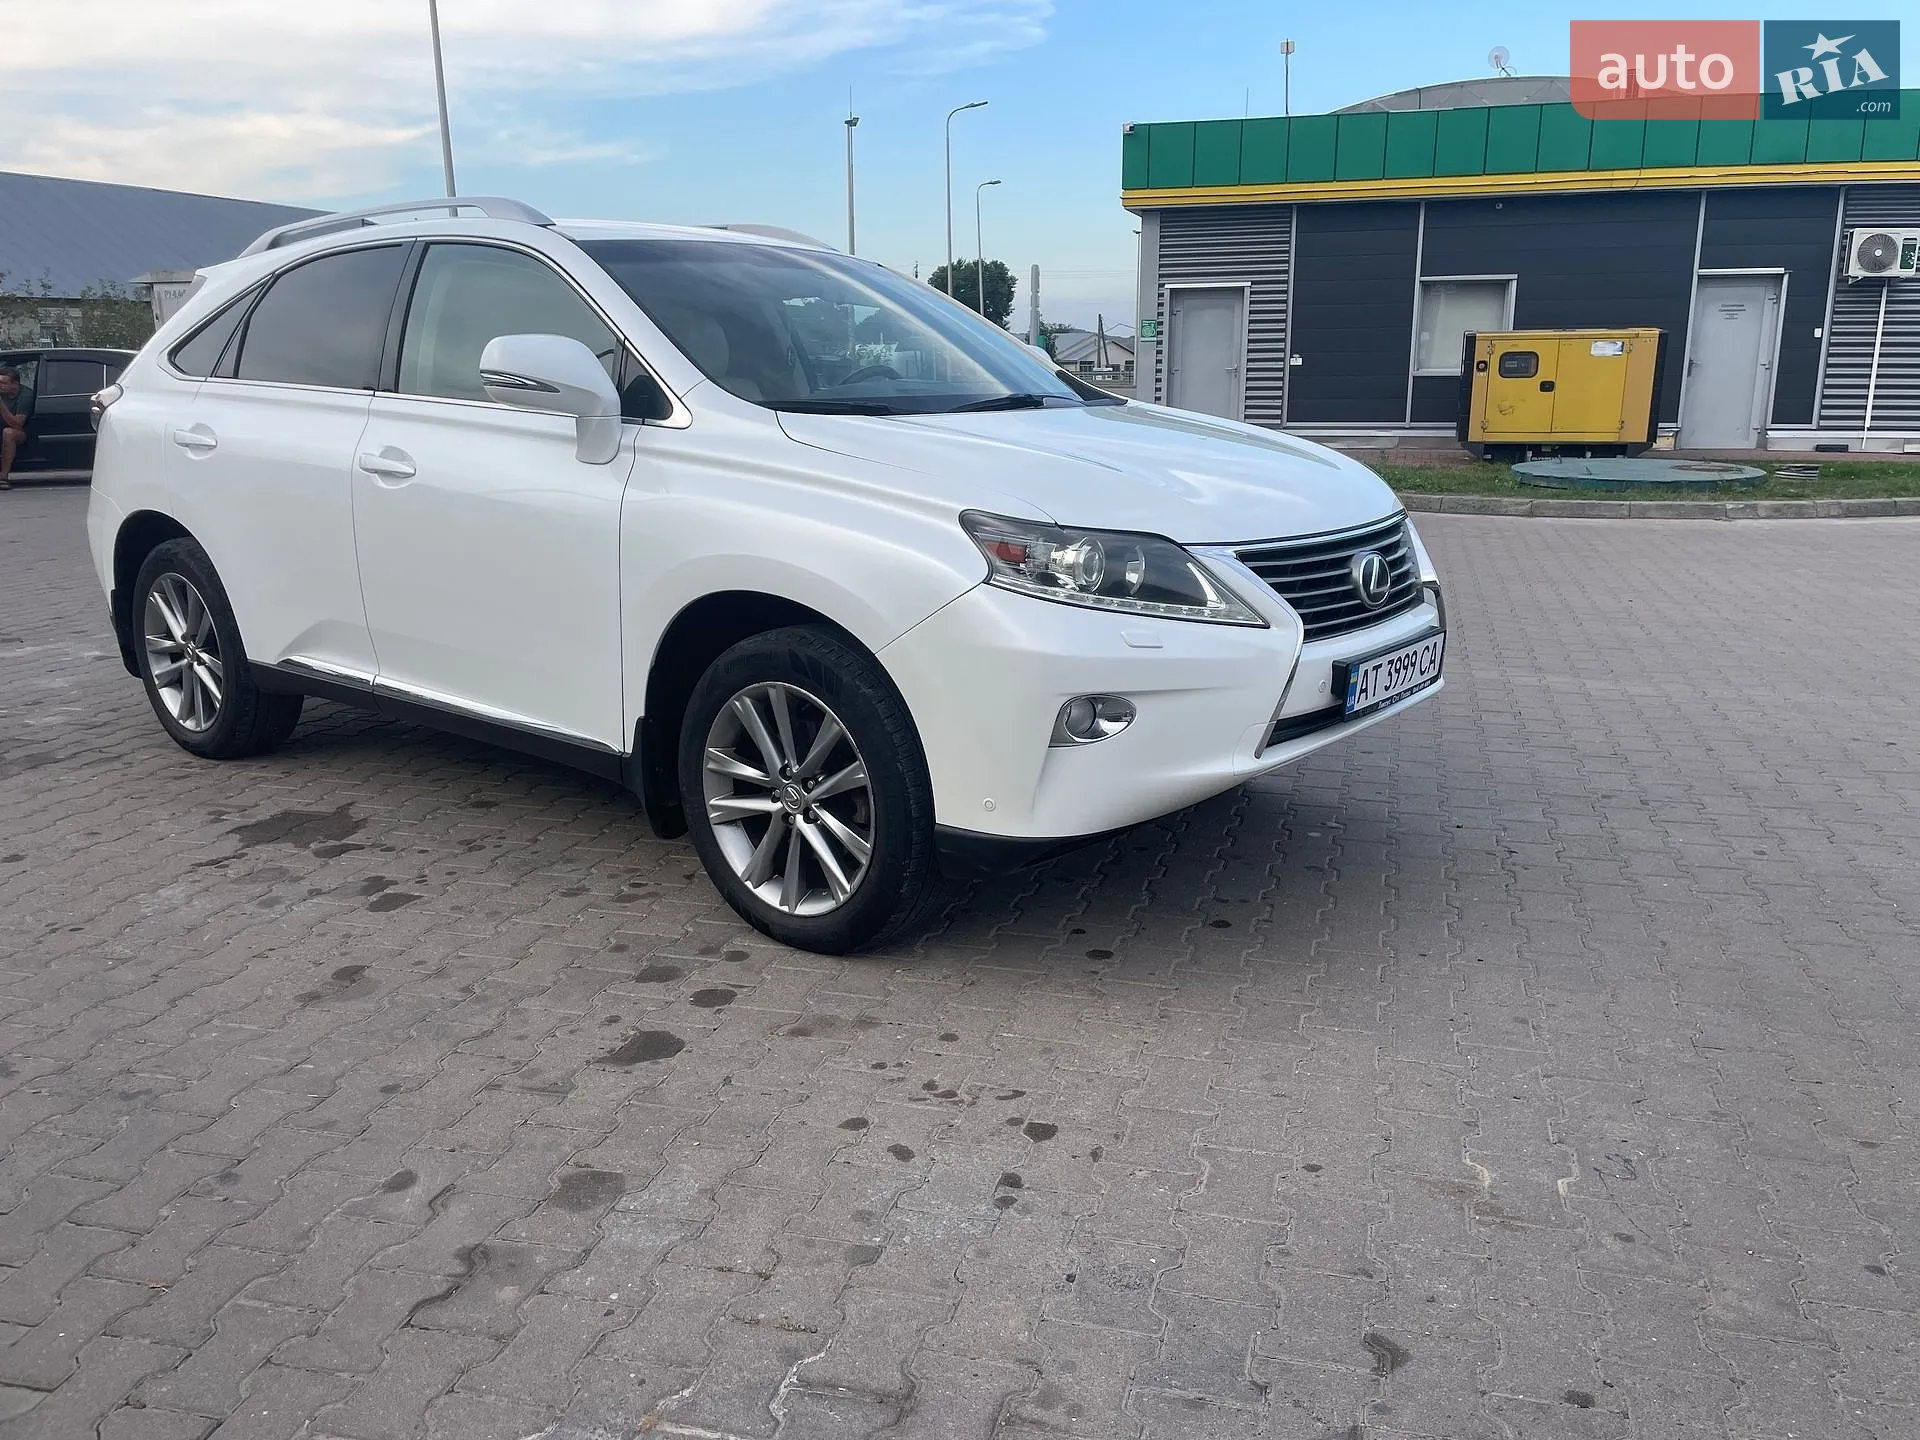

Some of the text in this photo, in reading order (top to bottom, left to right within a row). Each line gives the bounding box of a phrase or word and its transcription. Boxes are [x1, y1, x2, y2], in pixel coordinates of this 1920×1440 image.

[1357, 663, 1383, 703] AT
[1384, 650, 1417, 692] 3999
[1420, 641, 1437, 676] CA
